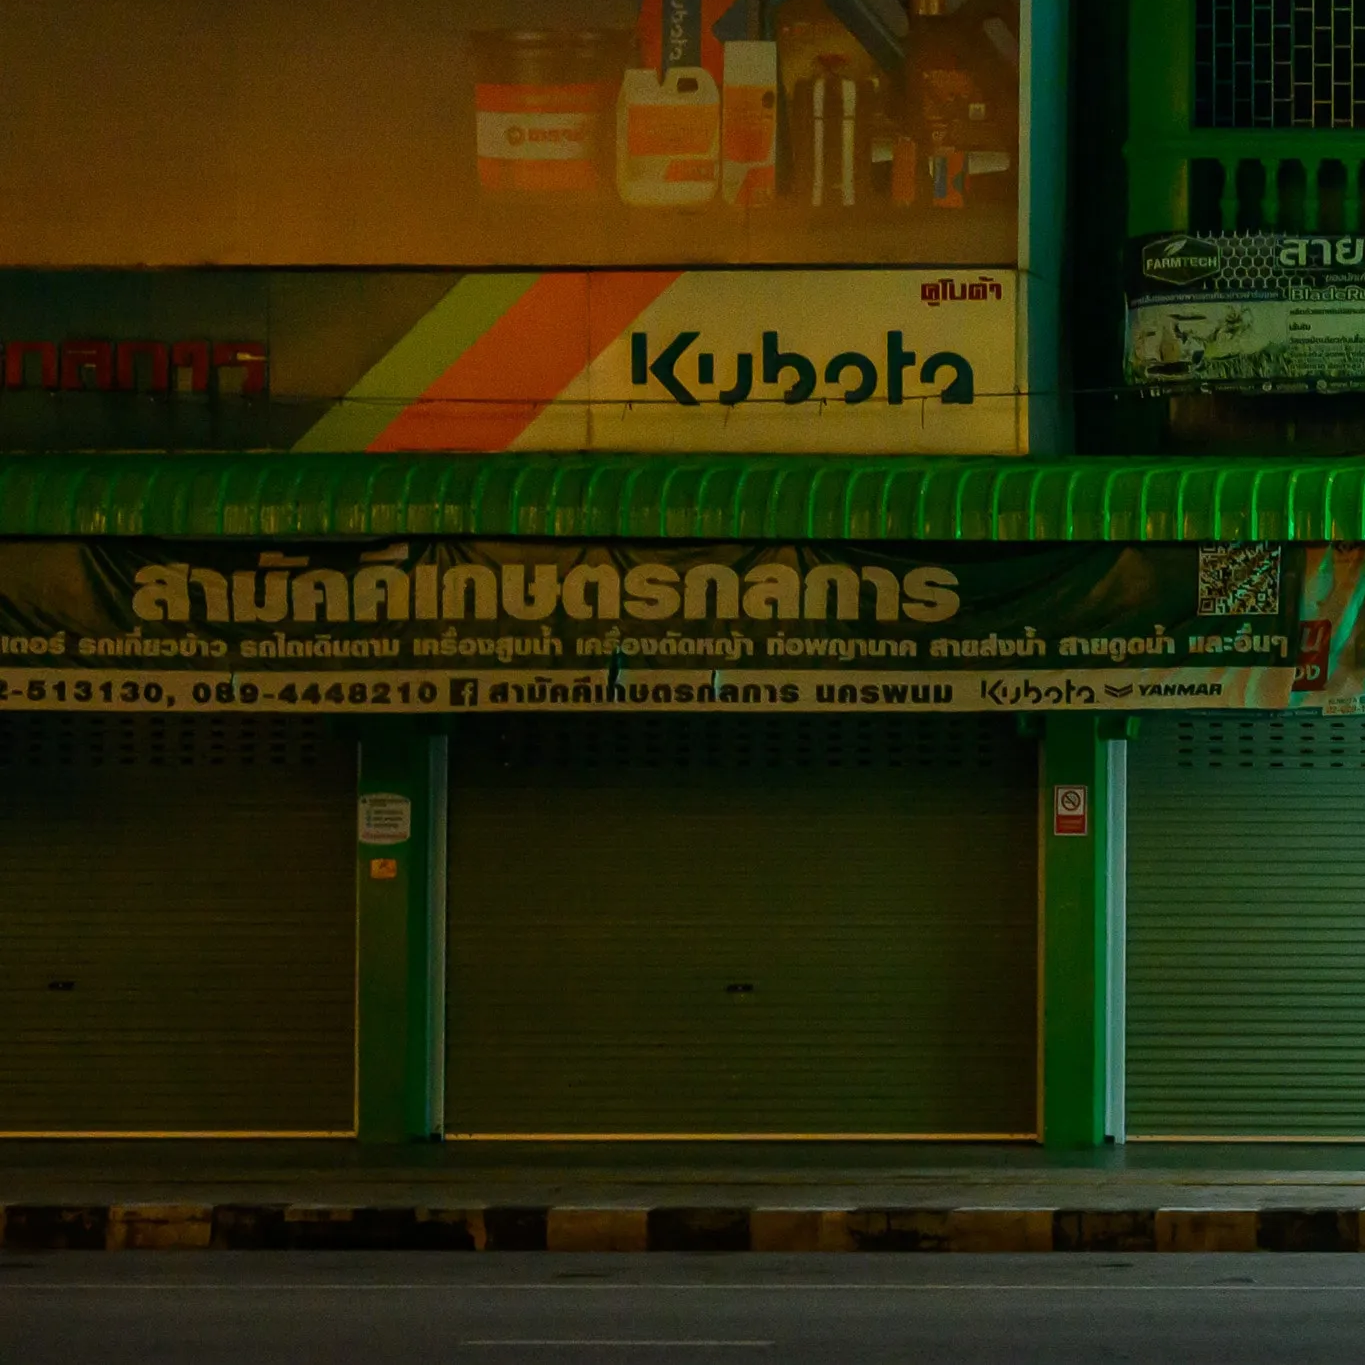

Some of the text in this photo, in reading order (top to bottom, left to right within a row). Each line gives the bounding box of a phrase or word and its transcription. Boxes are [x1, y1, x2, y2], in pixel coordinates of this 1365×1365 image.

[1146, 256, 1218, 271] FARMTECH
[921, 276, 1002, 307] คูโบต้า
[629, 329, 975, 406] Kubota
[131, 544, 961, 623] สามัคคีเกษตรกลการ
[79, 625, 228, 658] รถเกี่ยวข้าว
[240, 631, 398, 659] รถไถเดินตาม
[413, 625, 564, 663] เครื่องสูบน้ำ
[576, 625, 754, 661] เครื่องตัดหญ้า
[766, 631, 918, 662] ท่อพญานาค
[929, 626, 1047, 658] สายส่งน้ำ
[1058, 623, 1176, 662] สายดูดน้ำ
[1188, 622, 1289, 659] และอื่นๆ
[193, 681, 438, 705] 089-4448210
[489, 676, 799, 705] สามัคคีเกษตรกลการ
[815, 684, 953, 704] นครพนม
[981, 679, 1098, 704] Kubota
[1139, 683, 1223, 697] YANMAR
